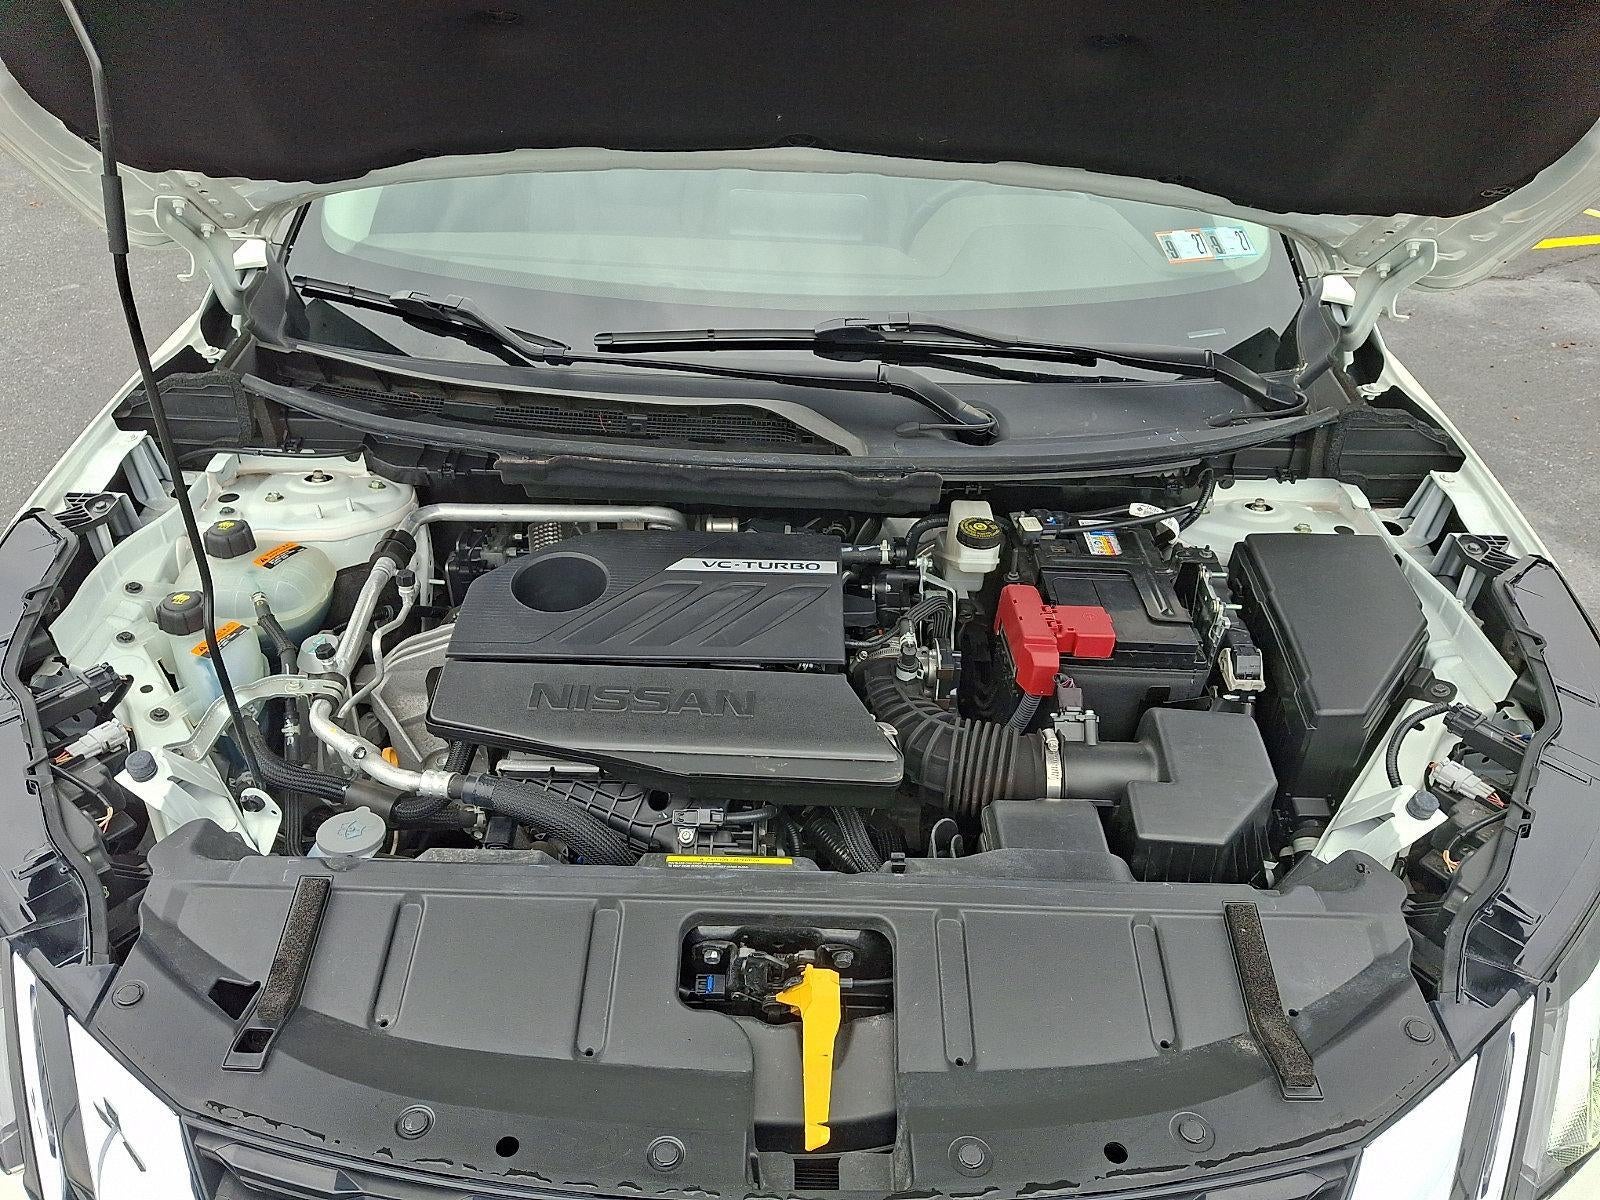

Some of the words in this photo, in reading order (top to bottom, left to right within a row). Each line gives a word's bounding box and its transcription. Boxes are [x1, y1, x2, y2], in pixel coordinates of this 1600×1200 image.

[1191, 233, 1208, 255] 27
[1234, 230, 1251, 251] 27
[701, 560, 821, 571] VC-TURBO
[526, 682, 755, 717] NISSAN
